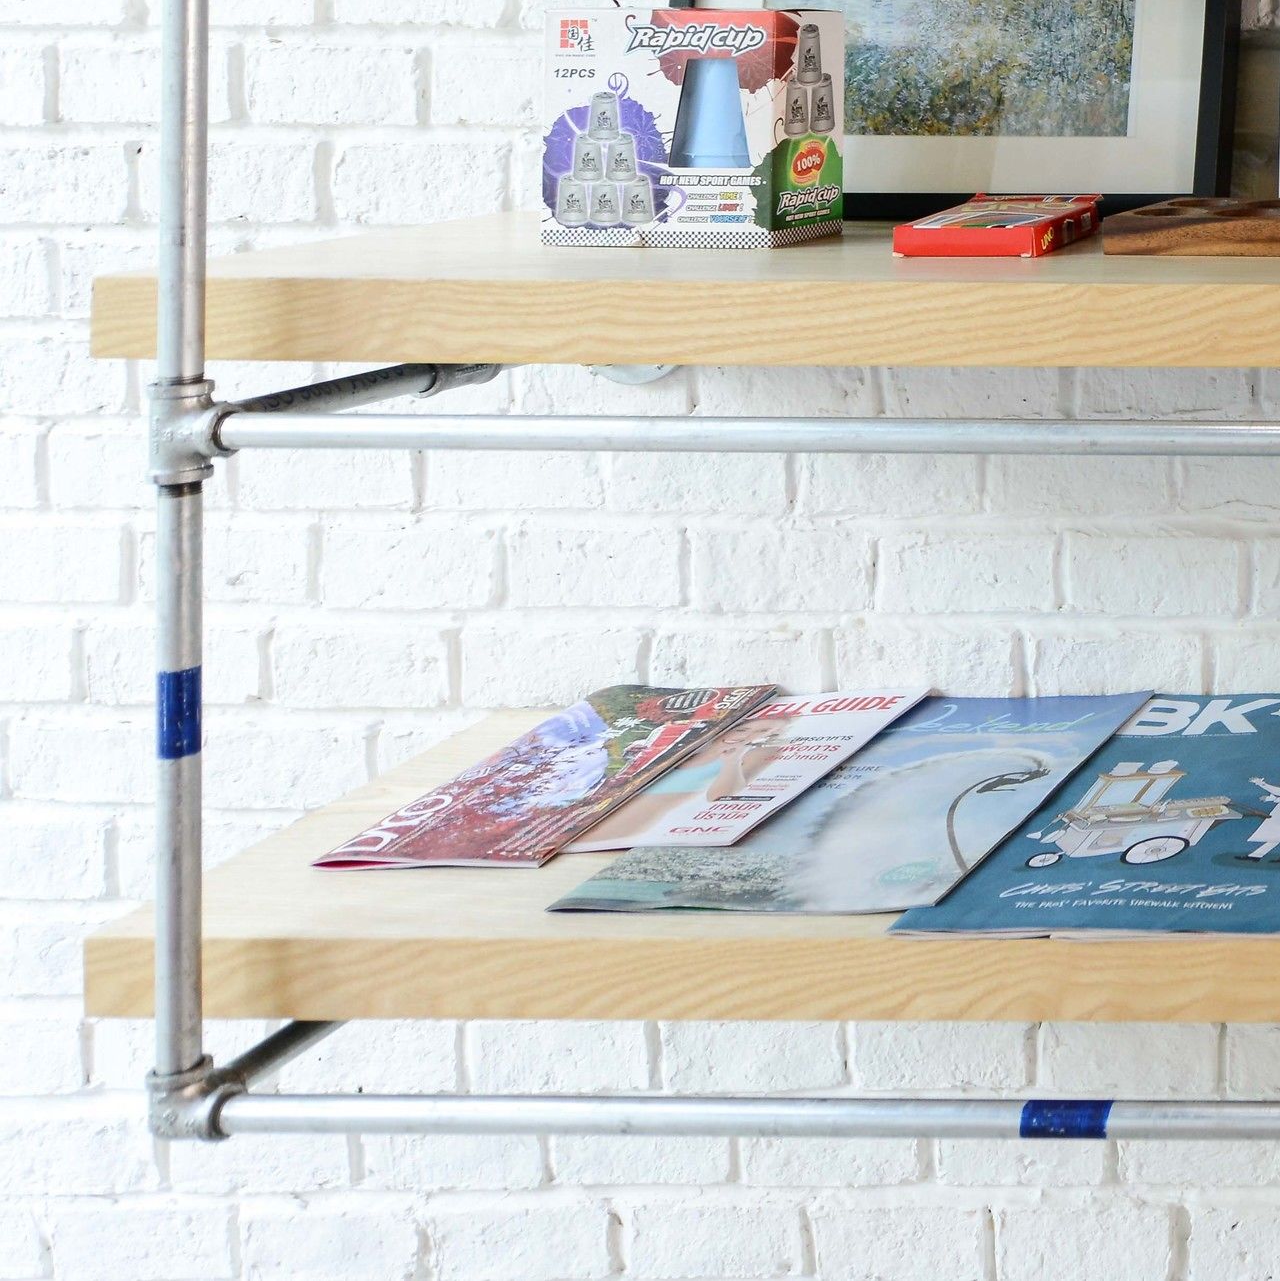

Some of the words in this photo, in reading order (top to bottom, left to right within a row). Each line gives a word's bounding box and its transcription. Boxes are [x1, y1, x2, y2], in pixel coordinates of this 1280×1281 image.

[625, 24, 714, 56] Rapid
[711, 24, 767, 55] cup
[553, 68, 597, 79] 12PCS
[796, 152, 822, 173] 100%
[660, 175, 678, 186] HOT
[678, 175, 700, 186] NEW
[699, 175, 731, 186] SPORT
[730, 175, 762, 186] GAMES
[777, 185, 819, 215] Rapid
[816, 184, 841, 207] cup
[1040, 226, 1056, 251] UNO
[811, 695, 906, 714] GUIDE
[669, 825, 734, 833] GNC
[1090, 879, 1206, 896] STREET
[1195, 883, 1268, 899] EATS
[1014, 900, 1035, 909] THE
[1038, 899, 1071, 909] PROS'
[1072, 898, 1127, 908] FAVORITE
[1129, 899, 1181, 909] SIDEWALK
[1183, 902, 1234, 911] KITCHENS
